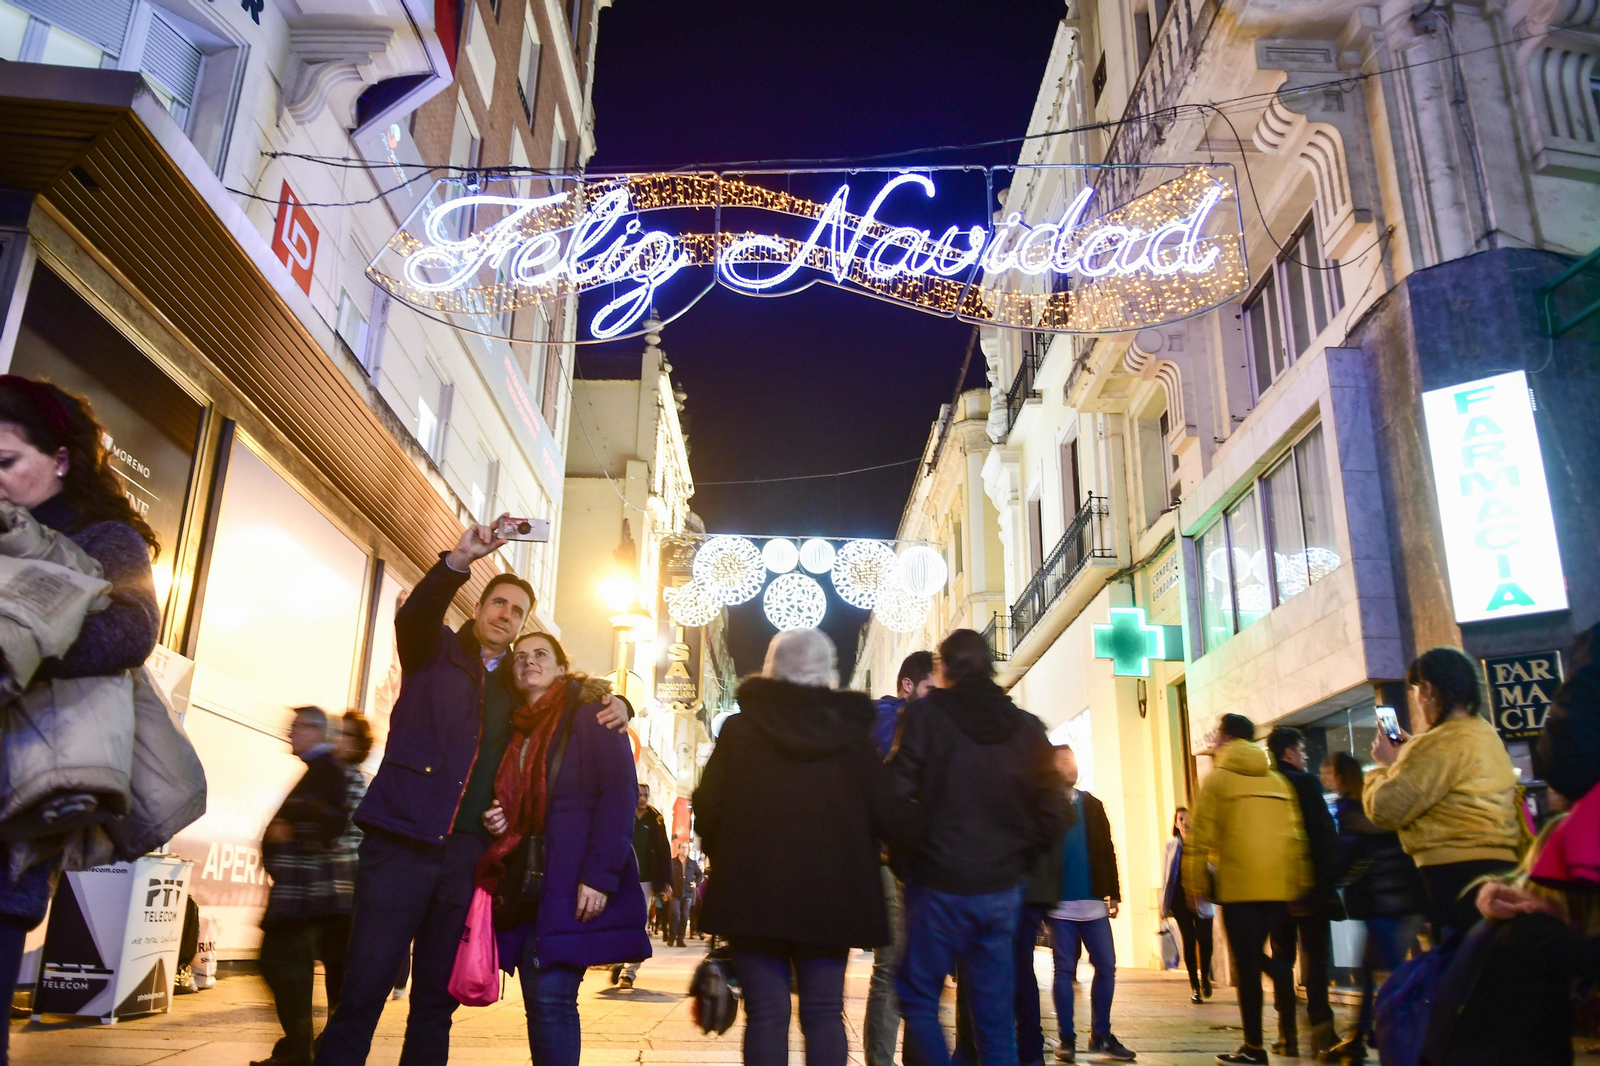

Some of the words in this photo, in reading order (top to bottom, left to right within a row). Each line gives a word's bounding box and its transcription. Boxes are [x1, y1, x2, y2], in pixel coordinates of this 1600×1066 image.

[403, 188, 690, 339] Feliz
[719, 173, 1224, 290] Navidad
[112, 444, 150, 479] MORENO
[1454, 385, 1537, 612] FARMACIA
[1493, 659, 1555, 684] FAR
[1499, 683, 1552, 707] MA
[42, 980, 89, 990] TELECOM
